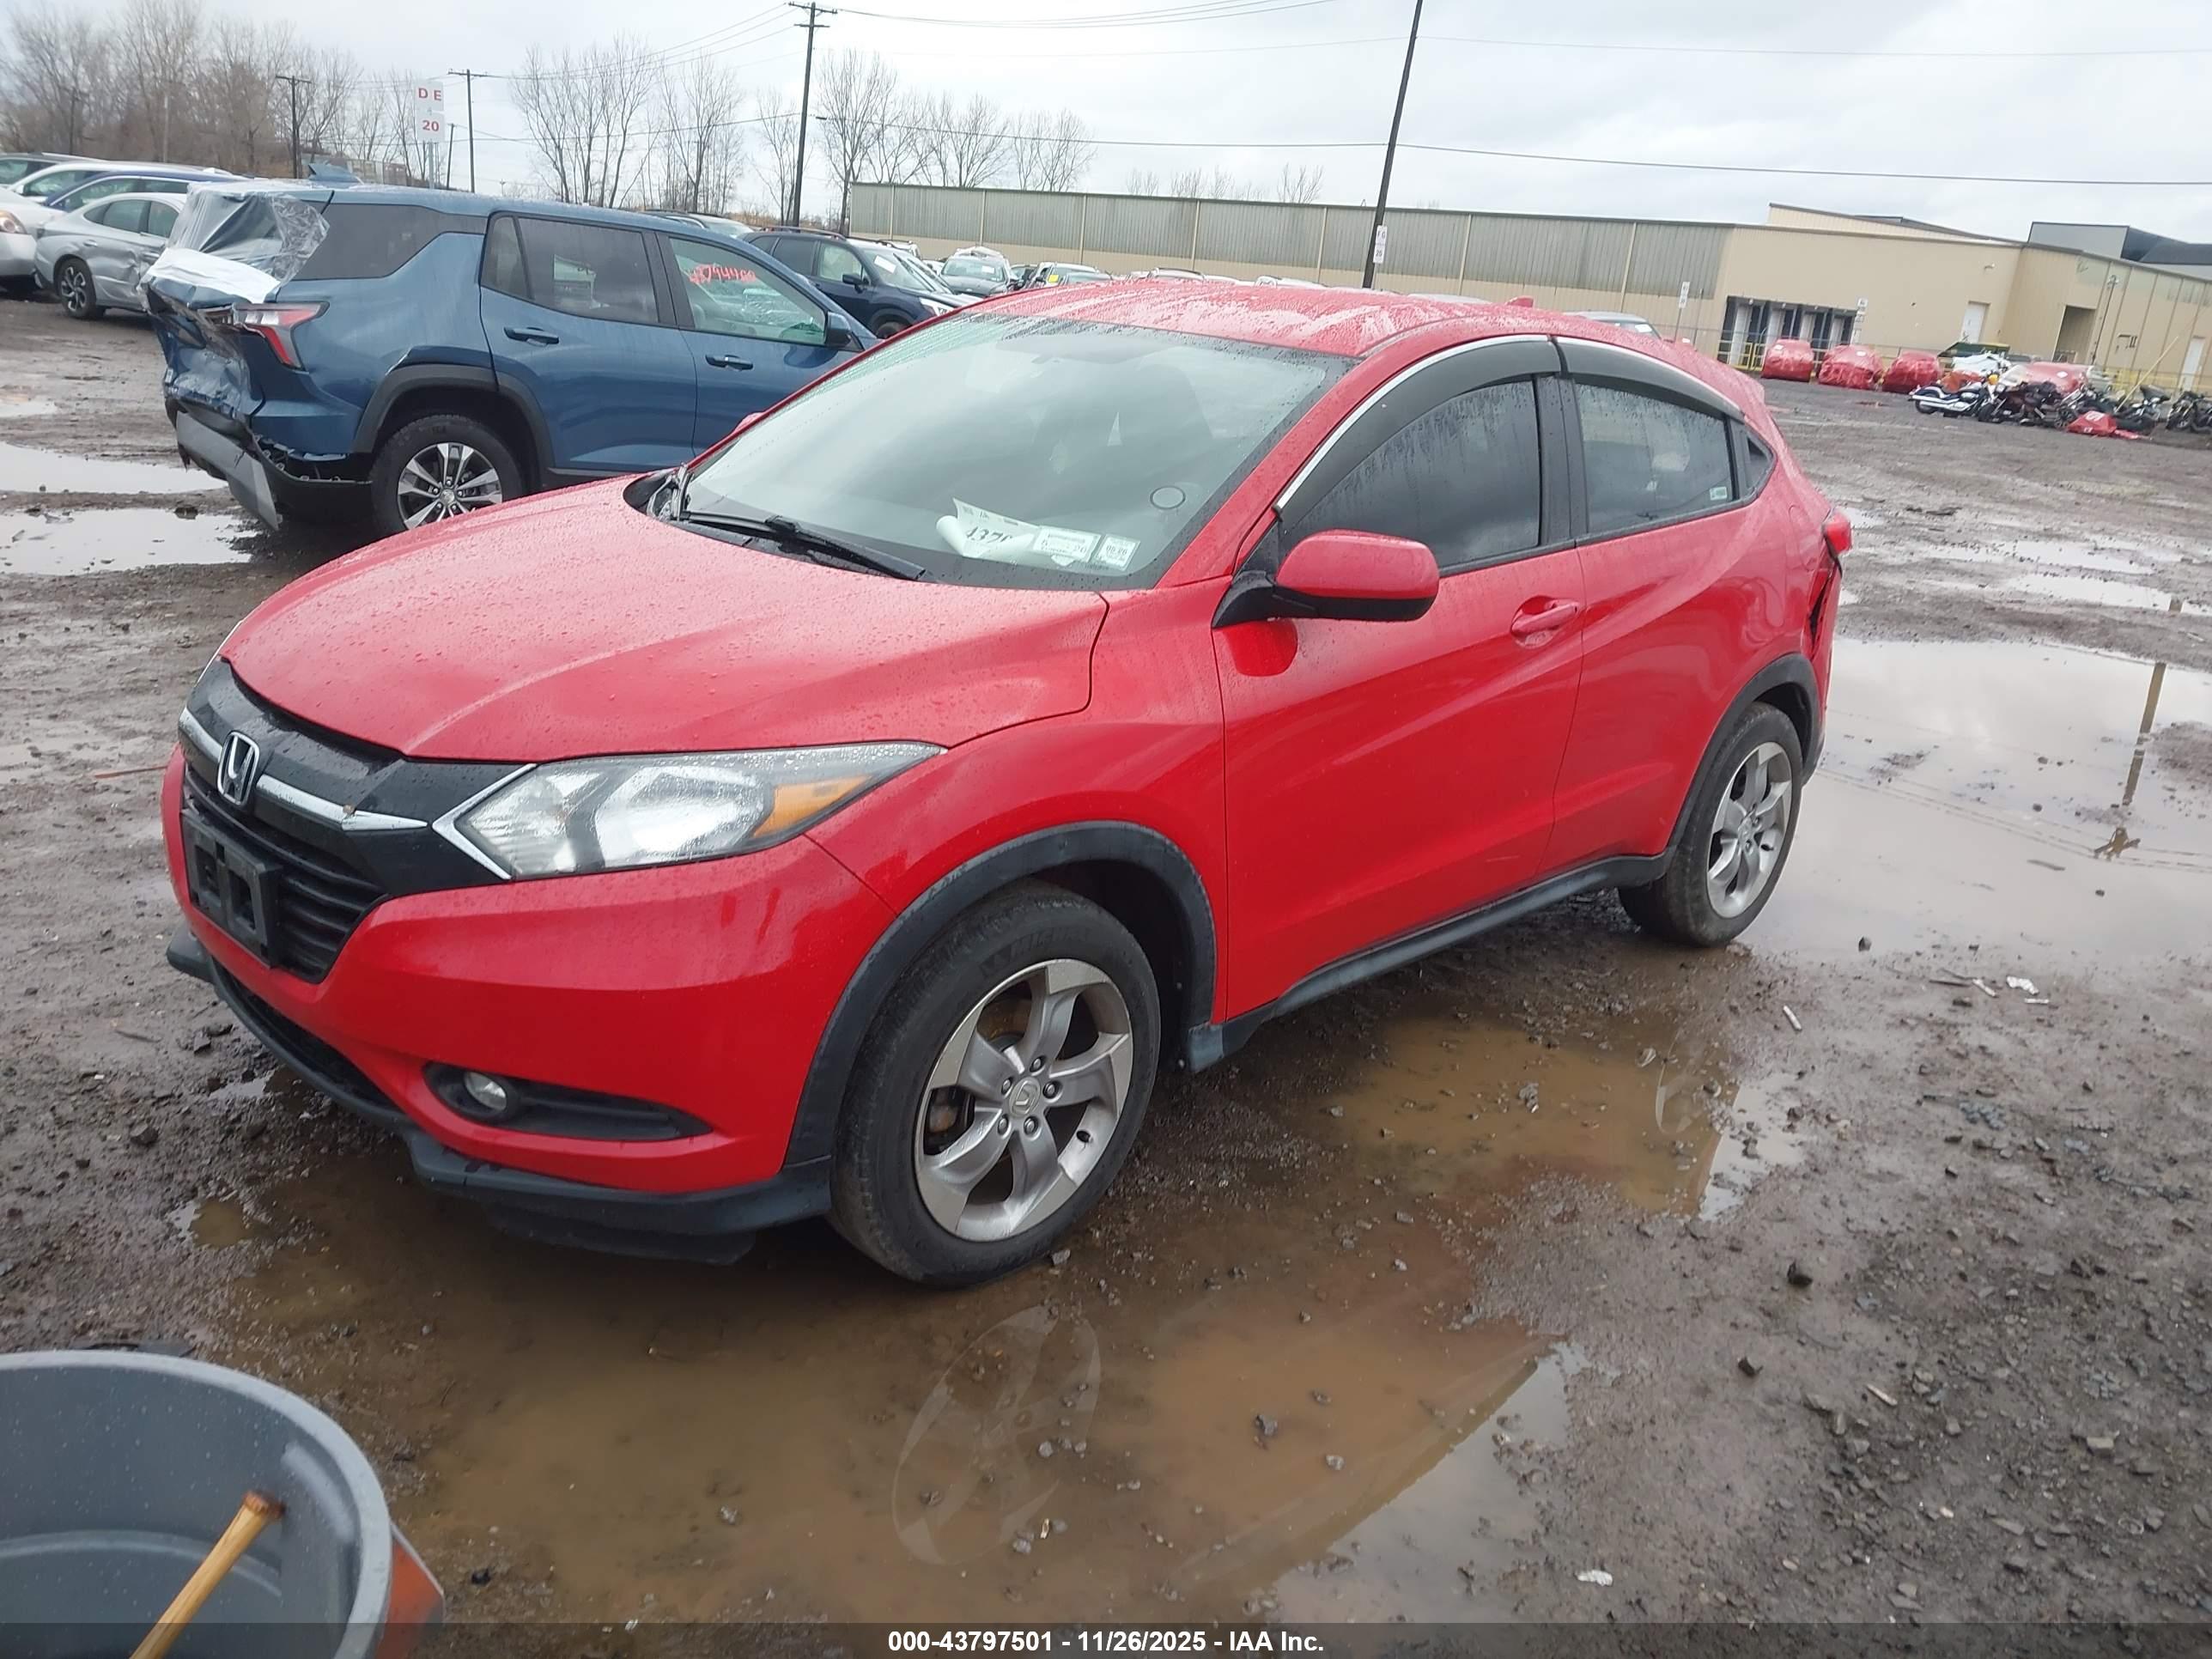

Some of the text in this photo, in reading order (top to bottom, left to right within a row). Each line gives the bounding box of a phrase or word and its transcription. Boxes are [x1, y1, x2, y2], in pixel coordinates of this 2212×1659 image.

[418, 88, 441, 101] D E
[422, 119, 440, 131] 20
